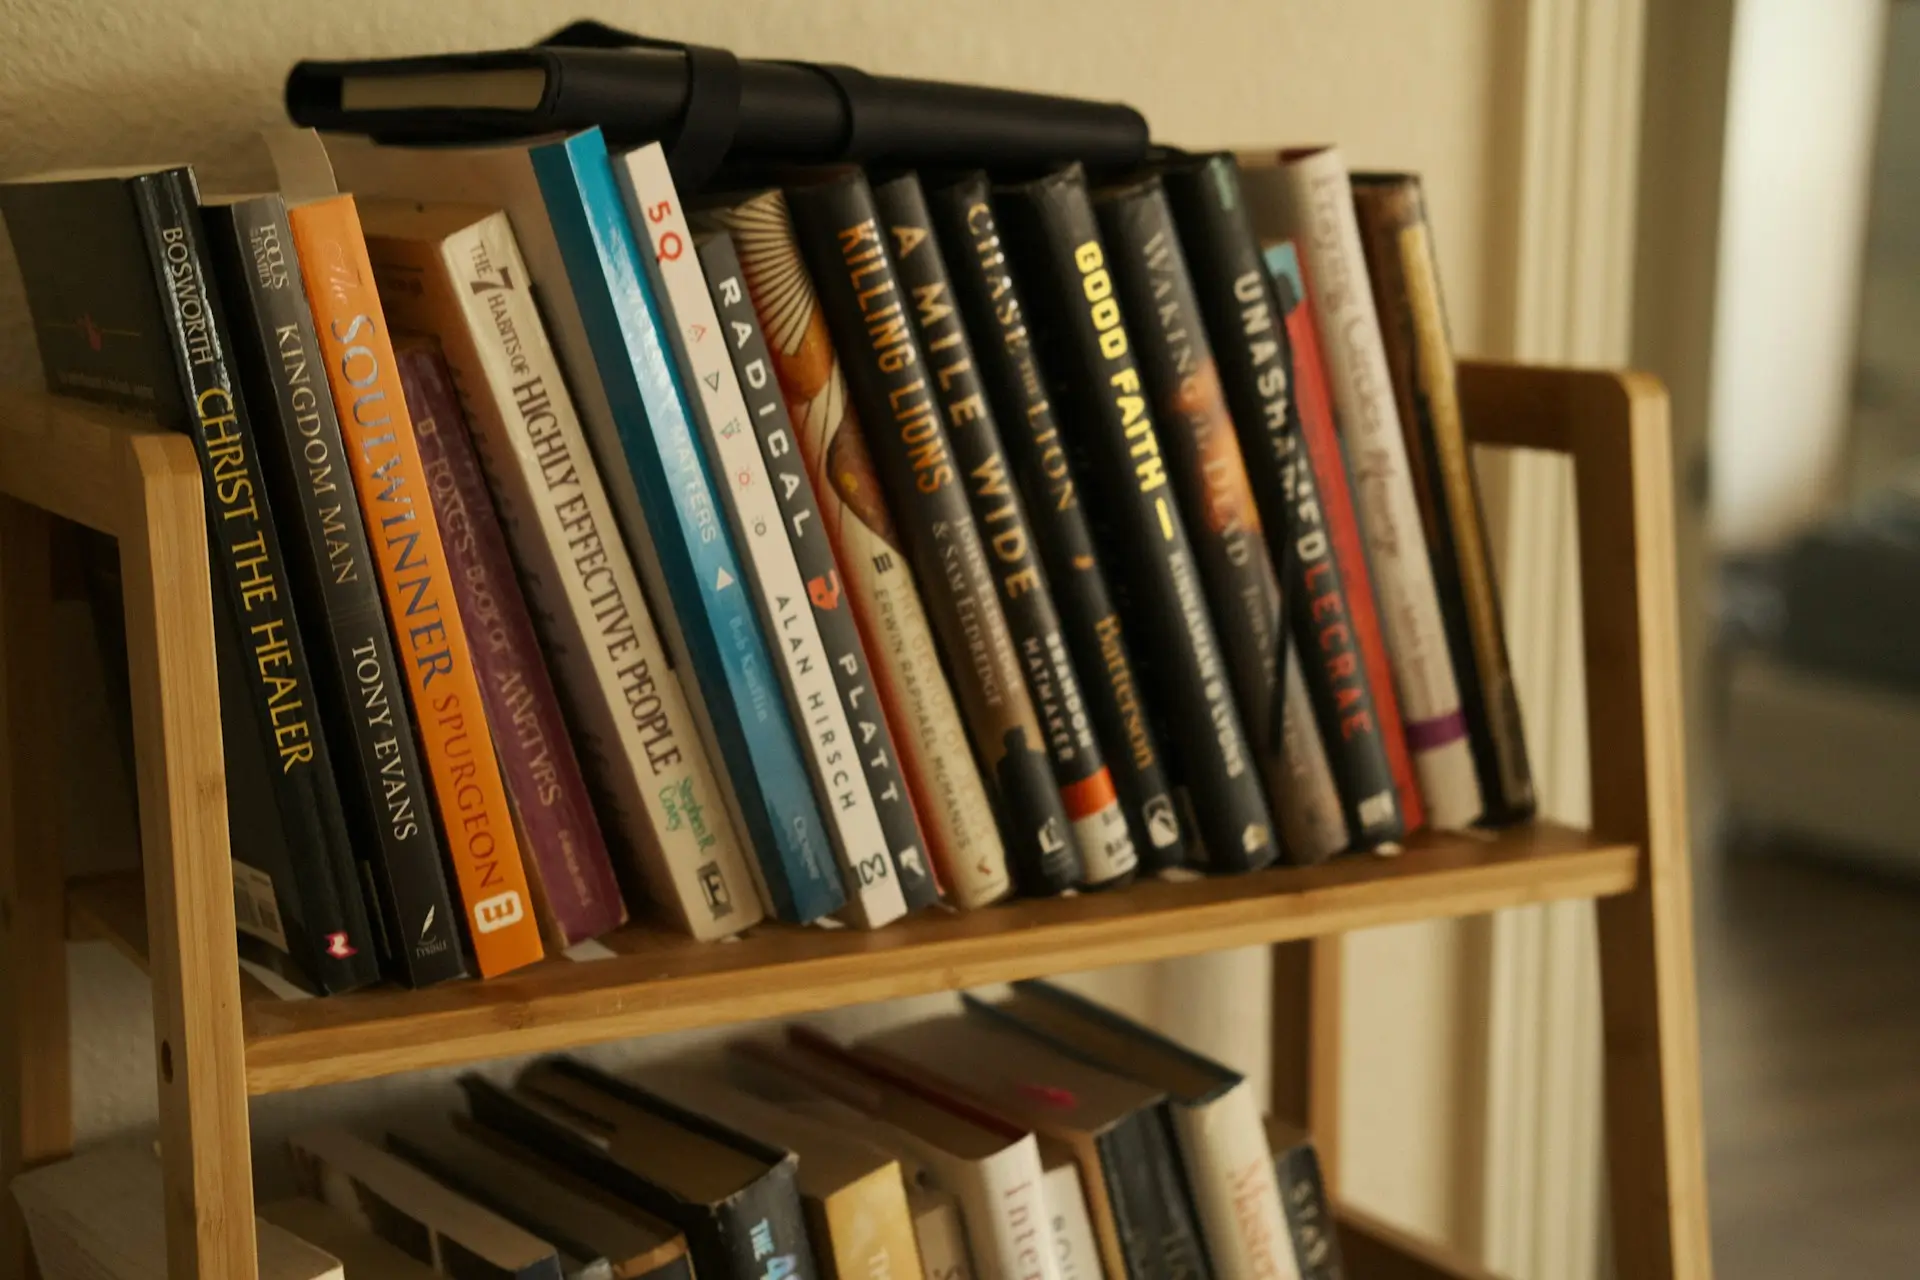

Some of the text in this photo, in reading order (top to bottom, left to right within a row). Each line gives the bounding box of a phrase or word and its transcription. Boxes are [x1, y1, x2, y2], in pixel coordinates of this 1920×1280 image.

[162, 226, 214, 365] BOSWORTH
[261, 224, 289, 289] FOCUS
[838, 217, 954, 493] KILLING LIONS
[967, 202, 1030, 355] CHASE
[1026, 399, 1078, 512] LION
[275, 322, 358, 586] KINGDOM MAN
[719, 276, 811, 538] RADICAL
[891, 226, 1042, 600] A MILE WIDE
[1074, 240, 1168, 493] GOOD FAITH
[1143, 231, 1200, 400] WAKING
[1203, 459, 1251, 567] DEAD
[197, 387, 313, 775] CHRIST THE HEALER
[331, 314, 454, 691] SOULWINNER
[469, 239, 682, 776] THE 7 HABITS OF HIGHLY EFFECTIVE PEOPLE
[670, 418, 716, 544] MATTERS
[351, 637, 419, 841] TONY EVANS
[498, 671, 562, 806] MARTYRS
[776, 595, 814, 676] ALAN
[807, 691, 857, 811] HIRSCH
[838, 653, 899, 802] PLATT
[874, 589, 904, 654] ERWIN
[902, 659, 937, 749] RAPHAEL
[1304, 561, 1372, 742] LECRAE
[432, 692, 504, 889] SPURGEON
[749, 1217, 775, 1262] THE
